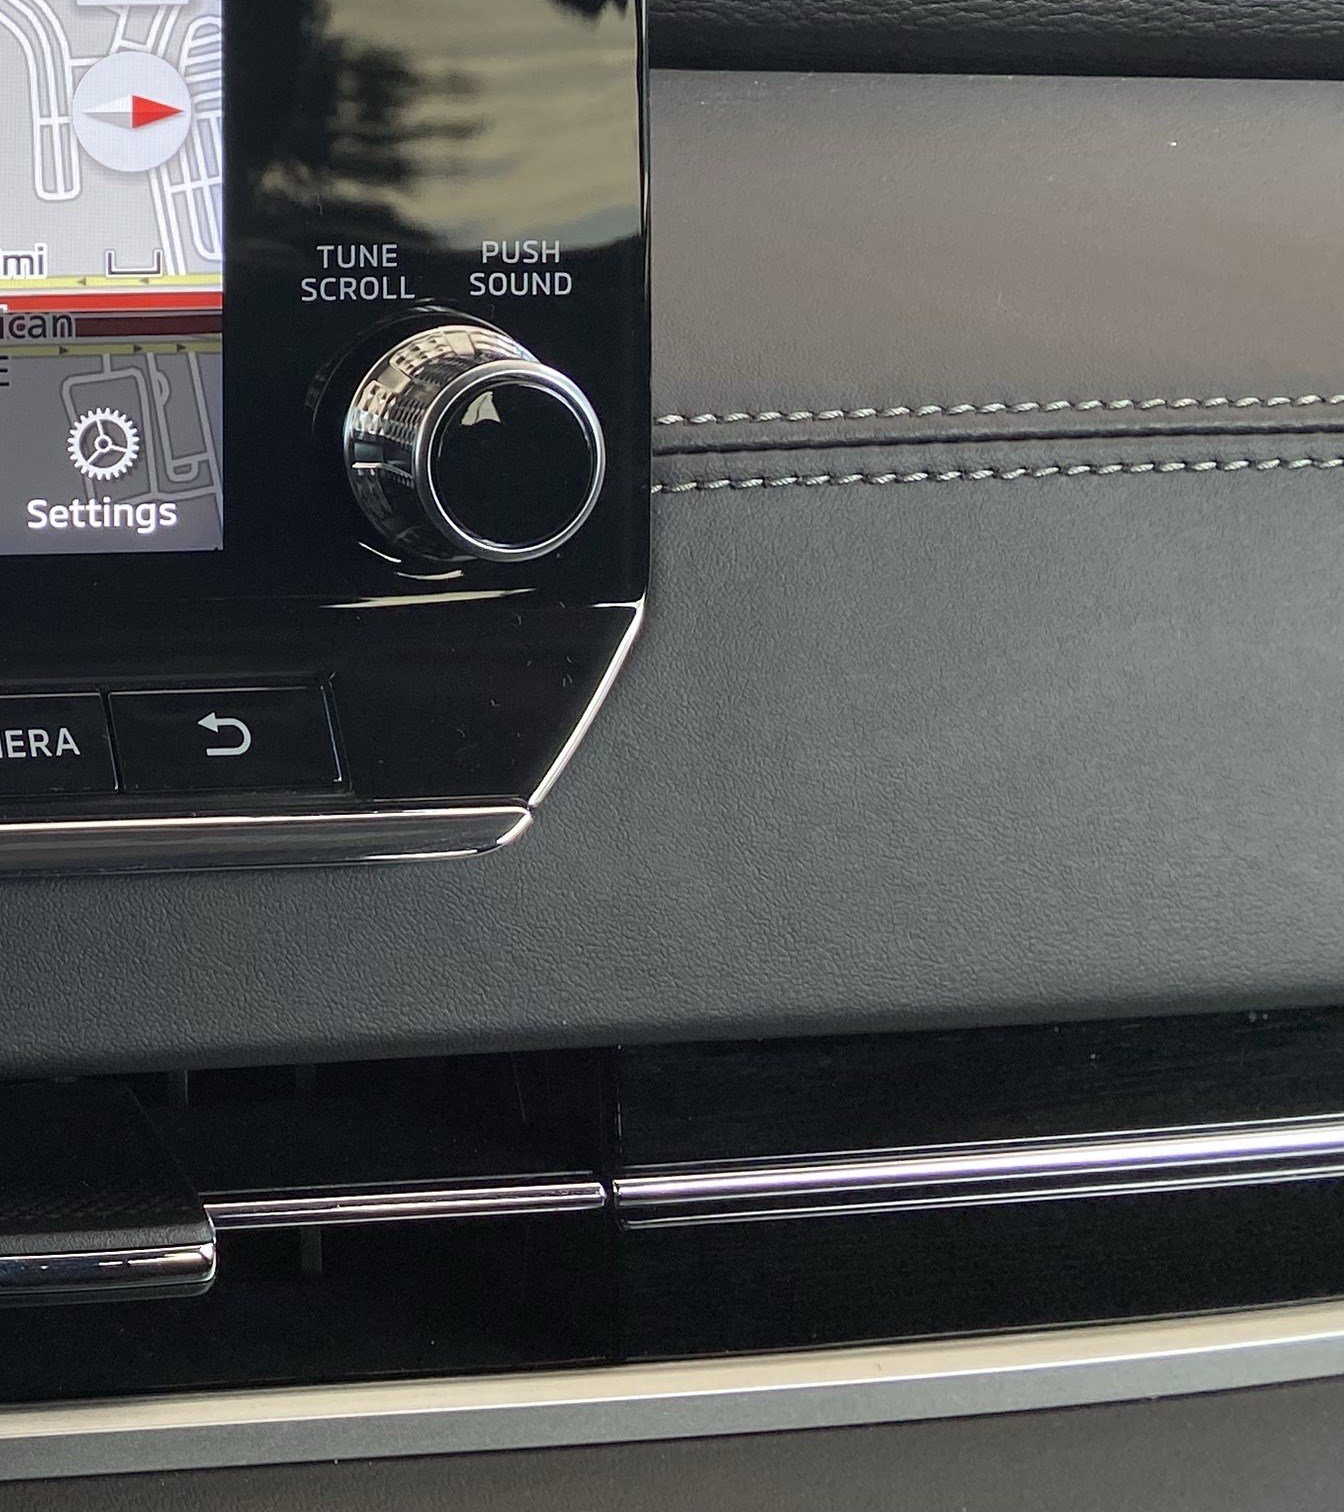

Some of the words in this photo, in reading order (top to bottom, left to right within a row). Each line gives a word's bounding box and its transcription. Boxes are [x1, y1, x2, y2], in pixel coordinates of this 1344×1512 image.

[316, 243, 399, 269] TUNE
[480, 239, 562, 265] PUSH
[300, 276, 417, 303] SCROLL
[468, 271, 573, 297] SOUND
[26, 496, 178, 535] Settings
